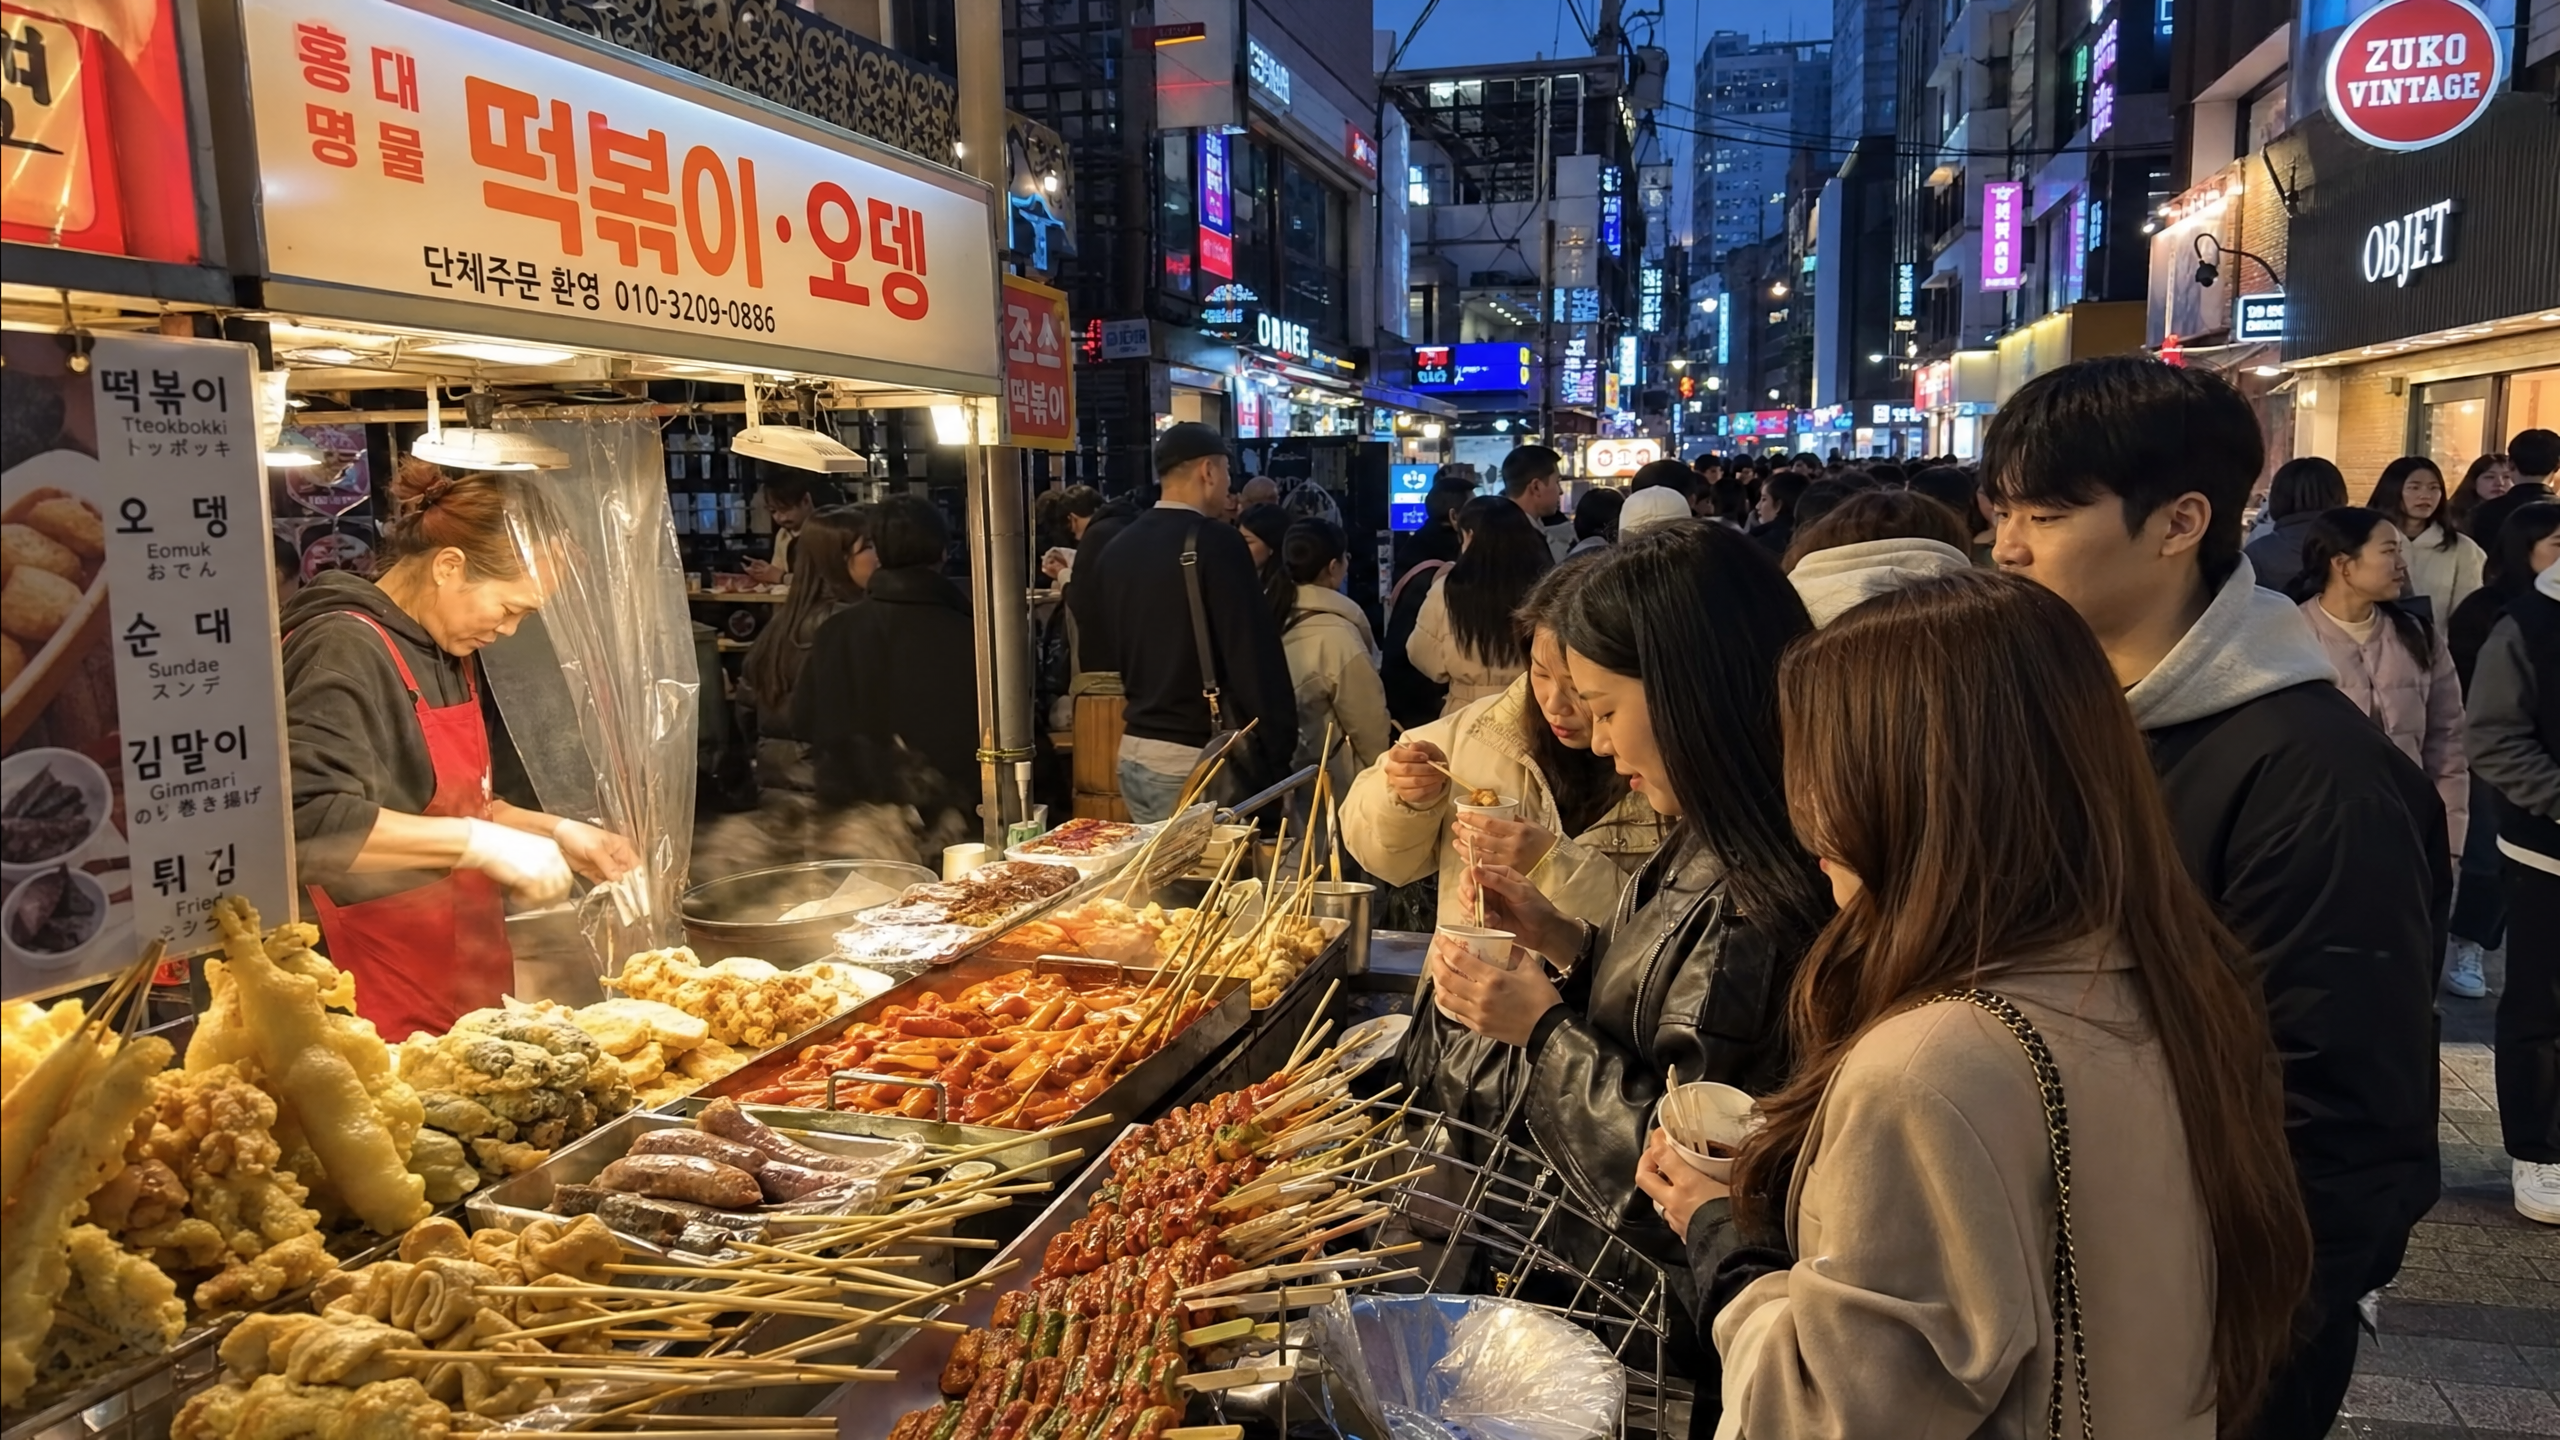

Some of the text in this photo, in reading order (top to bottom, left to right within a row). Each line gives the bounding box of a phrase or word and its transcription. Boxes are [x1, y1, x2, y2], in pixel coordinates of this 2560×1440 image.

[2365, 33, 2466, 73] ZUKO
[2347, 72, 2480, 108] VINTAGE
[2364, 198, 2451, 288] OBJET
[424, 246, 776, 333] 단체주문 환영 010-3209-0886
[1008, 304, 1061, 369] 조스
[101, 369, 227, 416] 떡볶이
[1011, 378, 1066, 426] 떡볶이
[121, 416, 228, 435] Tteokbokki
[147, 541, 212, 559] Eomuk
[147, 561, 216, 581] おでん
[123, 608, 230, 658] 순대
[148, 658, 220, 679] Sundae
[152, 675, 220, 700] スンデ
[128, 725, 247, 781] 김말이
[150, 772, 236, 801] Gimmari
